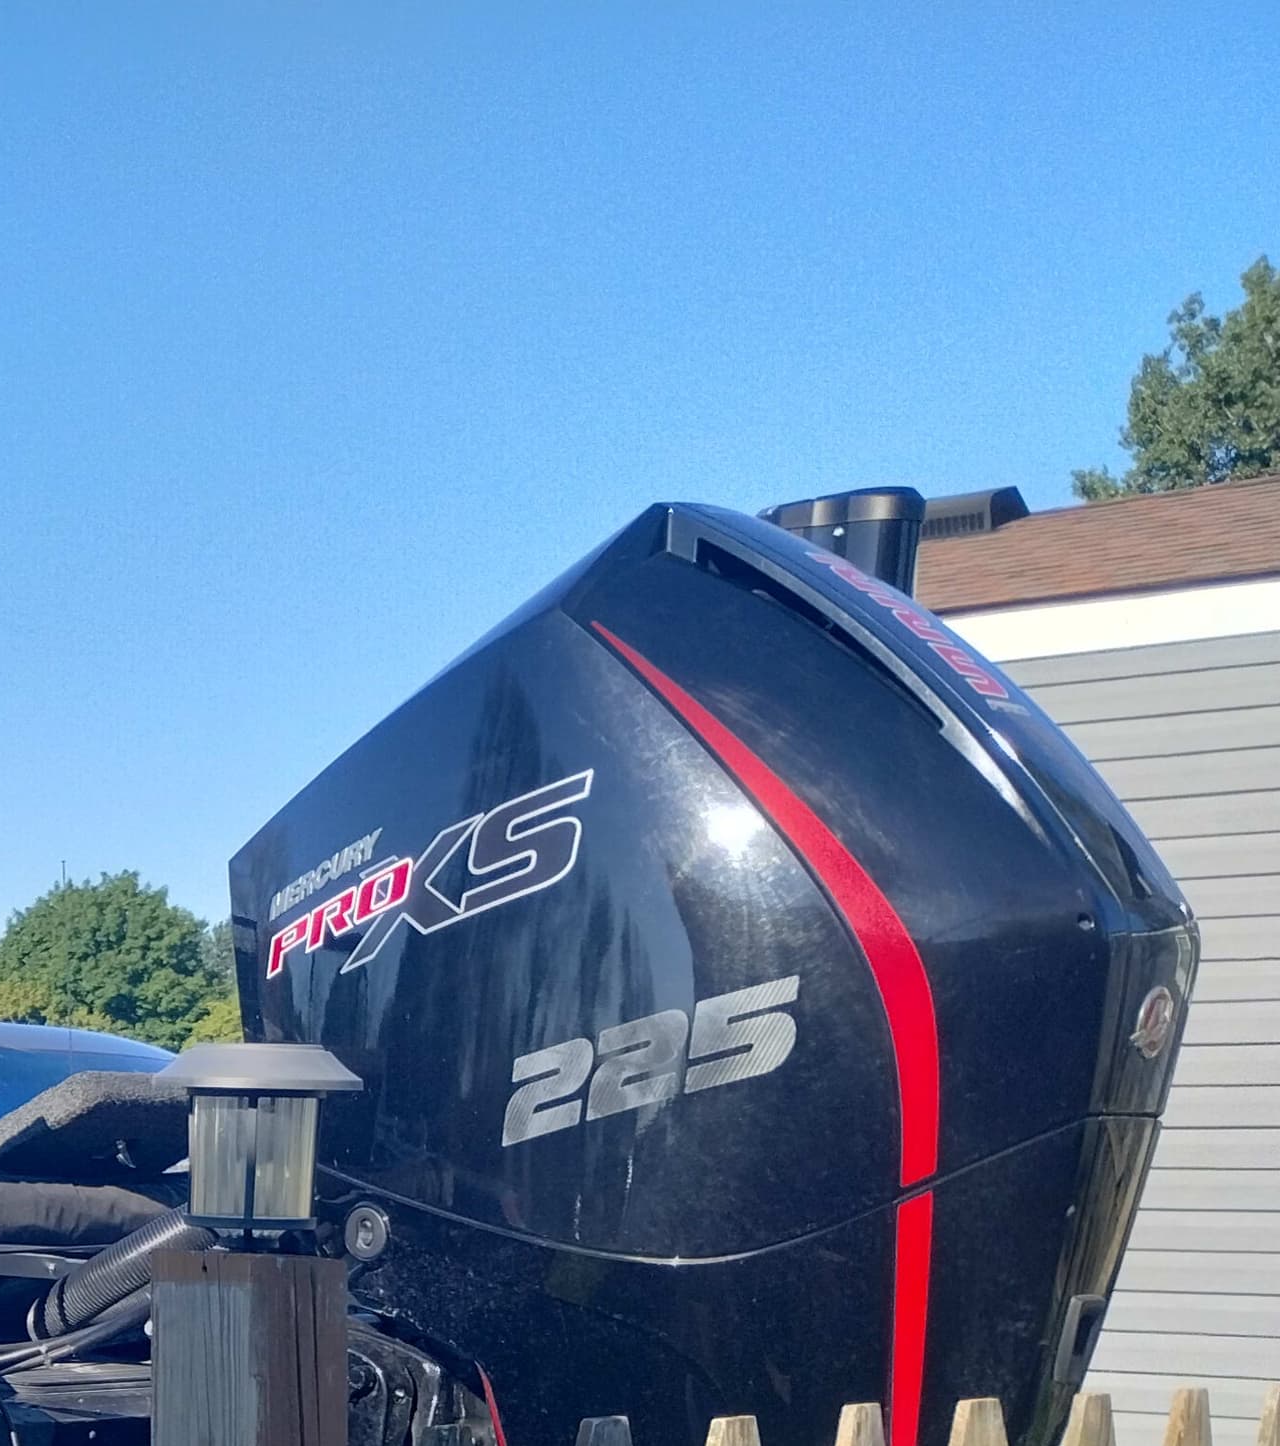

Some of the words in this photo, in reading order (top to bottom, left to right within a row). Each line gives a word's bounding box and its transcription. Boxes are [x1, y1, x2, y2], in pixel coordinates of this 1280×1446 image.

[266, 857, 414, 980] PRO
[340, 768, 594, 974] XS
[269, 828, 383, 922] MERCURY
[502, 975, 800, 1148] 225
